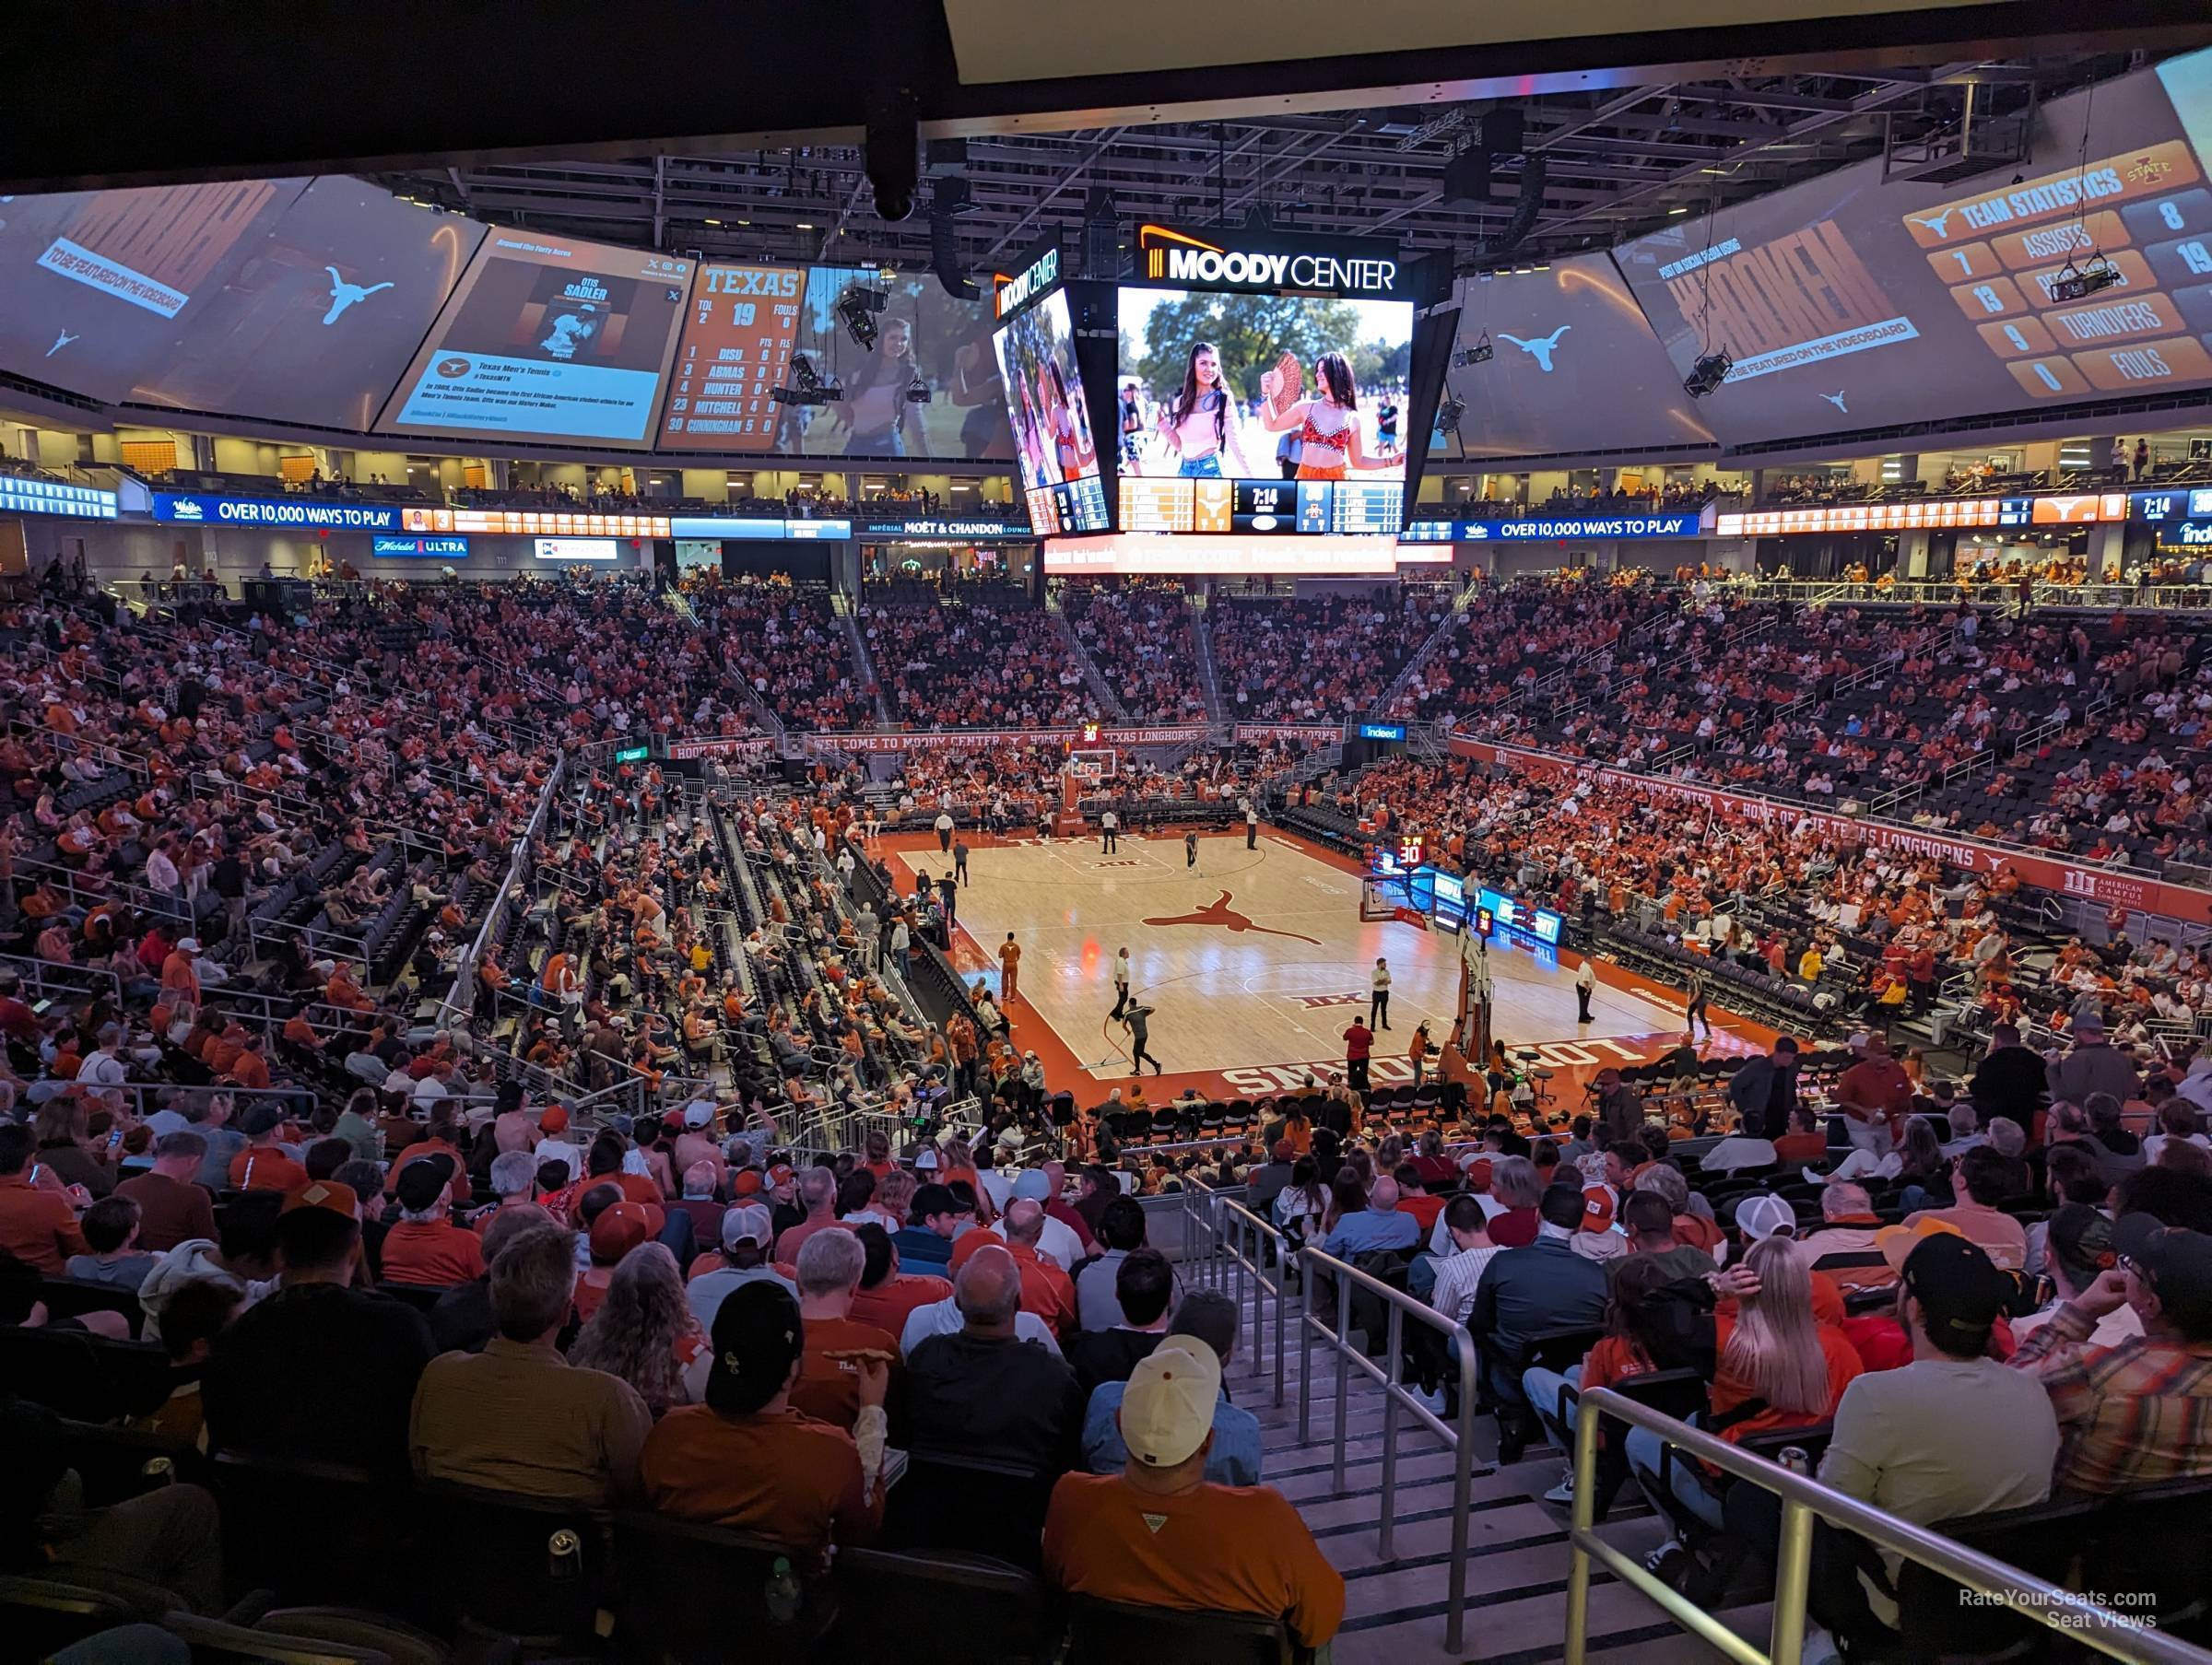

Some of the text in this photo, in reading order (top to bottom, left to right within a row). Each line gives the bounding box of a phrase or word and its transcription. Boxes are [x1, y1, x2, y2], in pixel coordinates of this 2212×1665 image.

[2127, 161, 2171, 182] STATE
[1959, 168, 2124, 229] TEAM STATISTICS
[2021, 223, 2093, 259] ASSISTS
[2159, 202, 2184, 229] 8
[1169, 249, 1397, 290] MOODY CENTER
[1659, 264, 1677, 280] POST
[1672, 261, 1685, 275] ON
[1680, 252, 1705, 271] SOCIAL
[581, 277, 599, 287] OTIS
[705, 268, 799, 297] TEXAS
[999, 247, 1057, 315] MOODY CENTER
[1973, 241, 2212, 313] 13 19
[564, 284, 607, 301] SADLER
[699, 299, 712, 311] TOL
[773, 304, 798, 316] FOULS
[699, 312, 708, 324] 2
[733, 303, 756, 326] 19
[782, 317, 791, 329] 0
[2004, 302, 2162, 351] 9 TURNOVERS
[759, 338, 772, 347] PTS
[1735, 365, 1749, 379] BE
[1748, 352, 1797, 374] FEATURED
[1797, 348, 1814, 360] ON
[1813, 342, 1835, 357] THE
[1834, 322, 1908, 350] VIDEOBOARD
[689, 346, 696, 358] 1
[718, 348, 744, 360] DISU
[780, 350, 786, 362] 1
[478, 362, 551, 376] Texas Men's Tennis
[685, 363, 782, 380] 3 ABMAS 0 1
[2033, 348, 2171, 391] 0 FOULS
[680, 381, 762, 395] 4 HUNTER 0
[673, 398, 776, 415] 23 MITCHELL 4 0
[668, 418, 771, 433] 30 CUNNINGHAM 5 0
[1253, 488, 1277, 505] 7:14
[2144, 498, 2171, 513] 7:14
[218, 503, 391, 526] OVER 10,000 WAYS TO PLAY
[437, 513, 449, 529] 3
[904, 521, 937, 534] MOËT
[938, 523, 947, 534] &
[948, 523, 1004, 535] CHANDON
[1501, 522, 1535, 537] OVER
[1537, 522, 1582, 539] 10,000
[1583, 521, 1622, 534] WAYS
[1624, 521, 1645, 534] TO
[1647, 520, 1683, 534] PLAY
[374, 539, 466, 554] Michelob ULTRA
[1030, 729, 1199, 745] HOME OF TEXAS LONGHORNS
[1083, 730, 1097, 742] 30
[1240, 729, 1269, 739] HOOK
[1366, 725, 1397, 738] indeed
[881, 737, 897, 749] TO
[950, 735, 1001, 746] CENTER
[1670, 786, 1712, 804] CENTER
[1400, 846, 1419, 863] 30
[1882, 834, 1974, 866] LONGHORNS
[2098, 885, 2142, 900] CAMPUS
[2099, 879, 2142, 893] AMERICAN
